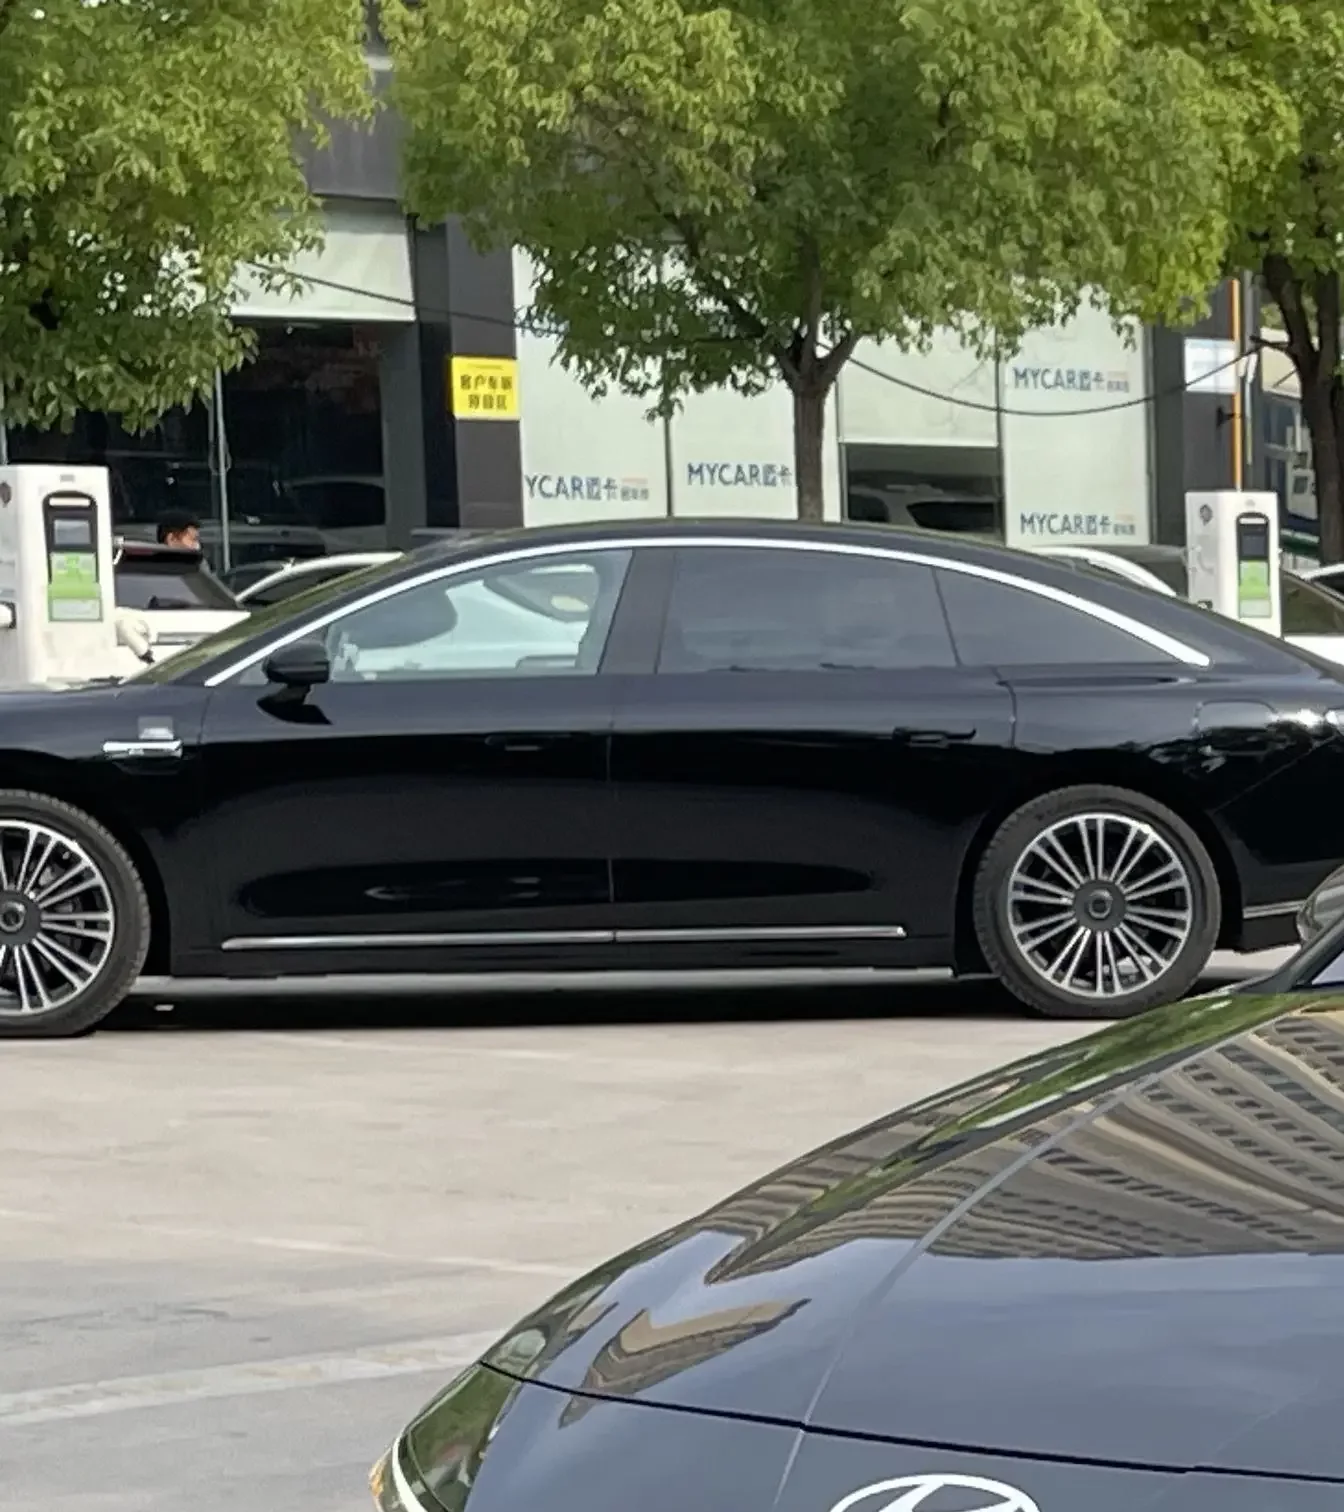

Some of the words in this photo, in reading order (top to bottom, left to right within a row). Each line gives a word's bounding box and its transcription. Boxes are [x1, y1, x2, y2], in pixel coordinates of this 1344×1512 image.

[1014, 367, 1076, 390] MYCAR
[686, 462, 760, 487] MYCAR
[1020, 511, 1084, 536] MYCAR
